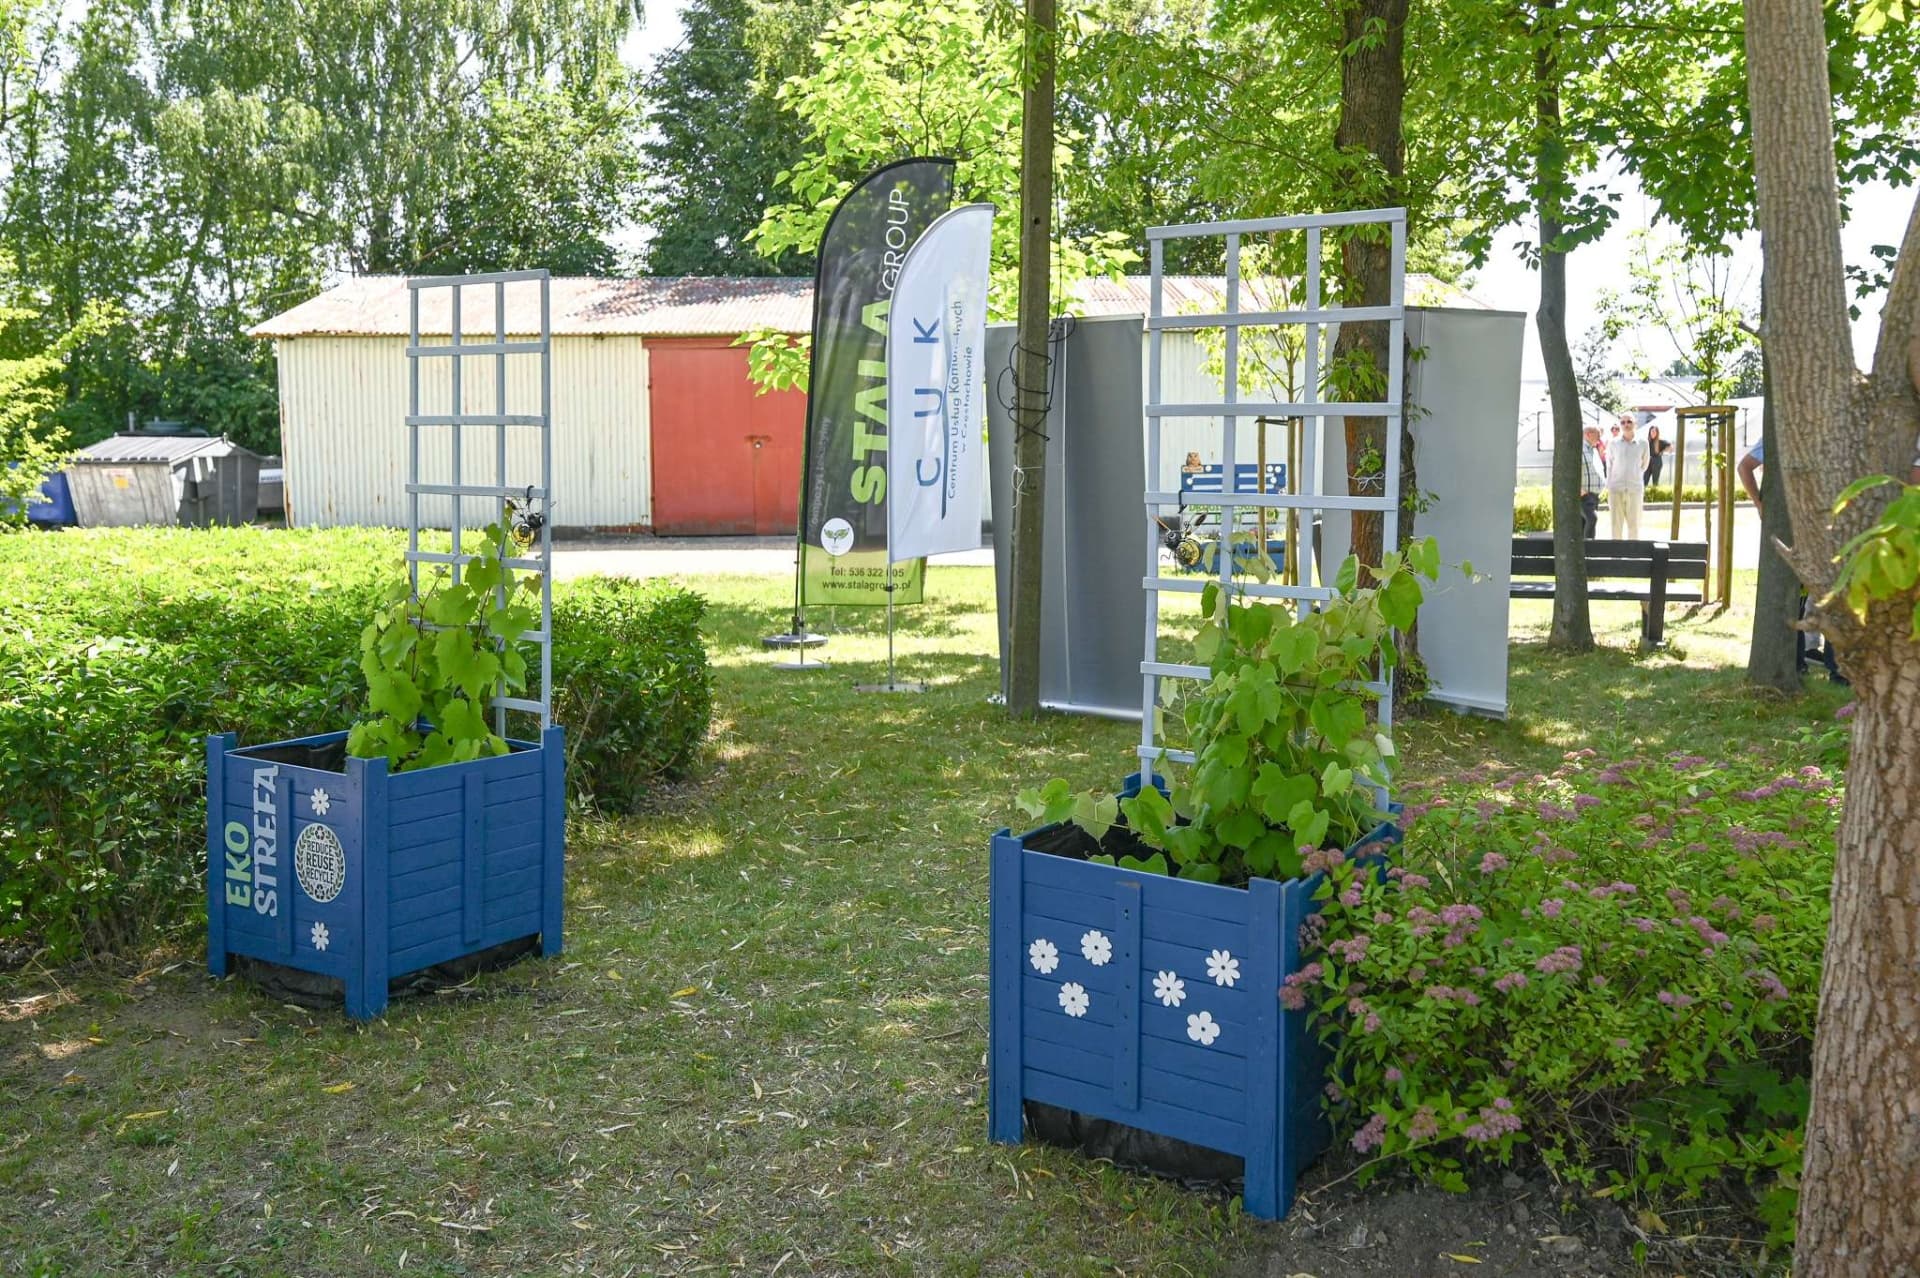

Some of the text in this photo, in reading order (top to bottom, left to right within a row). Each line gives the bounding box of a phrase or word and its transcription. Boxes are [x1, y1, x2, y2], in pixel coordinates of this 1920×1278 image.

[882, 188, 910, 291] GROUP
[948, 441, 959, 499] Centrum
[822, 580, 911, 592] www.stalagrop.pl
[253, 764, 279, 918] STREFA
[306, 840, 334, 857] REDUCE
[224, 821, 252, 908] EKO
[305, 867, 334, 884] RECYCLE
[306, 852, 334, 871] REUSE
